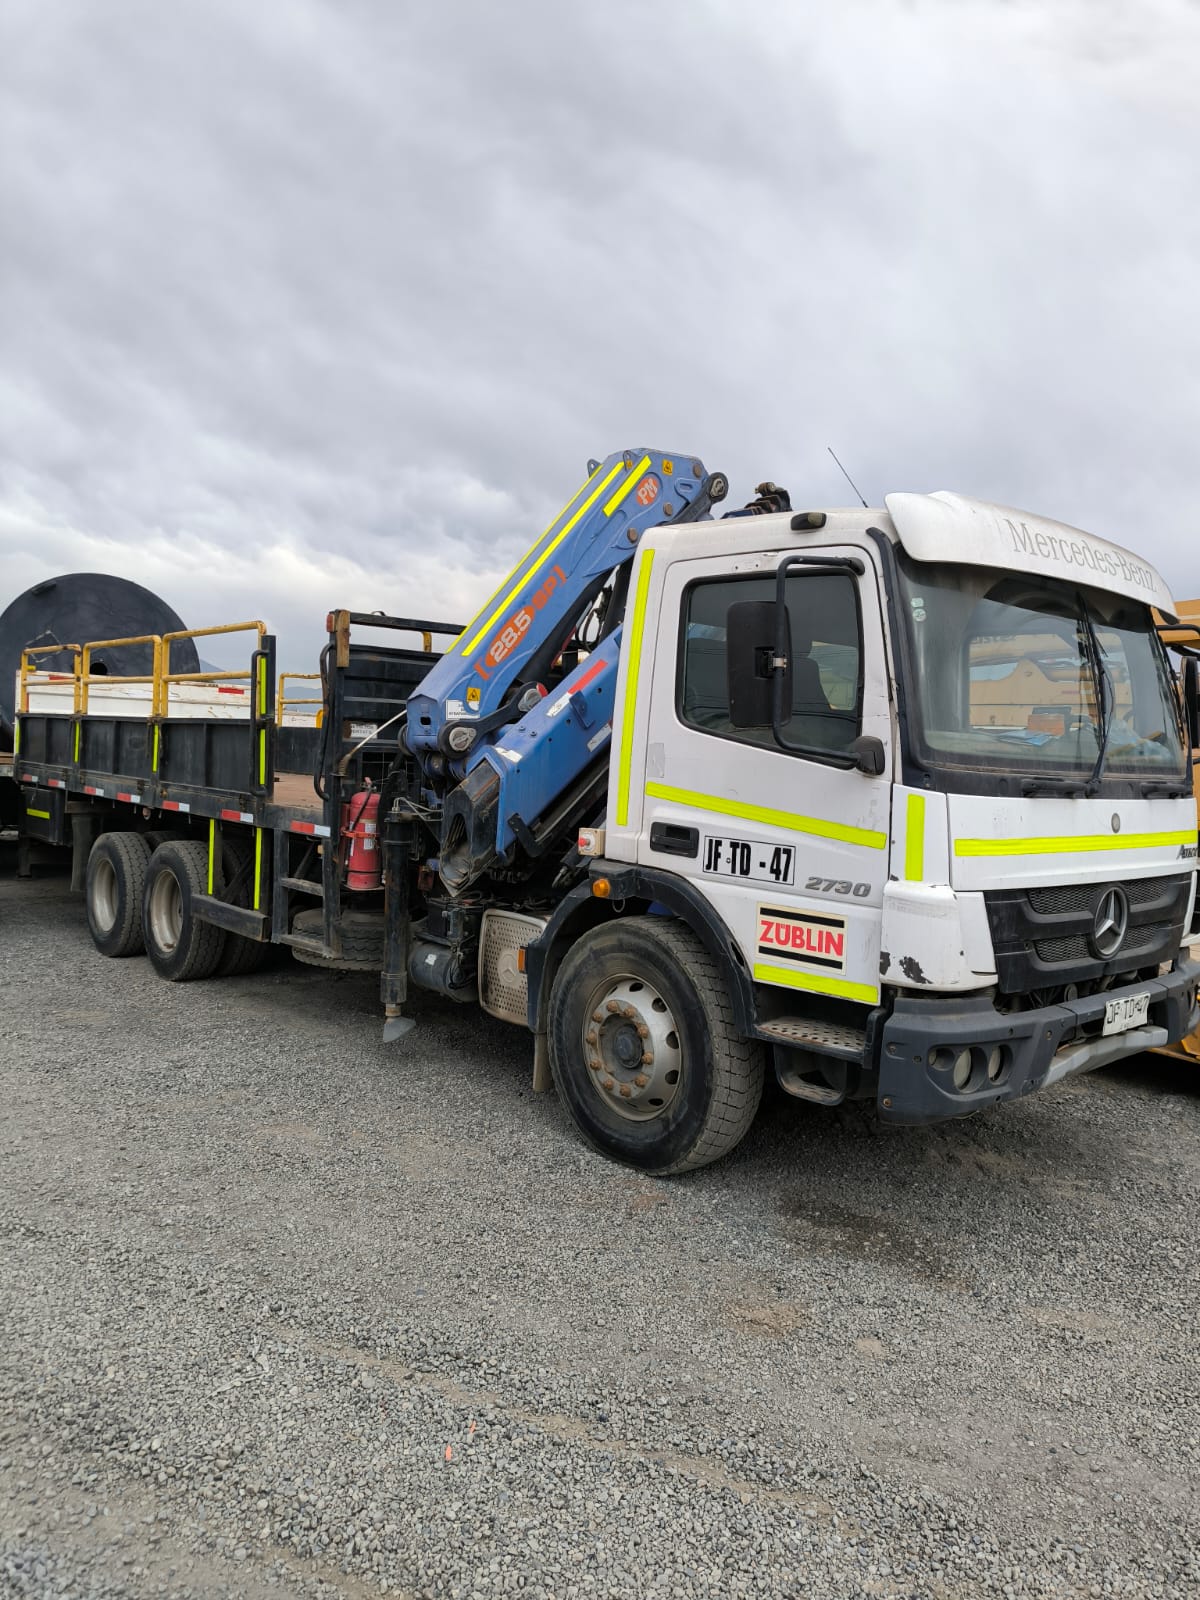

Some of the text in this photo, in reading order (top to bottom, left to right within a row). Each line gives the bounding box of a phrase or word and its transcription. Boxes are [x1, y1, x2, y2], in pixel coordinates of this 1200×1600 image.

[638, 478, 658, 505] PM
[1003, 518, 1157, 593] Mercedes-Benz
[805, 876, 871, 897] 2730
[759, 920, 844, 957] ZÜBLIN
